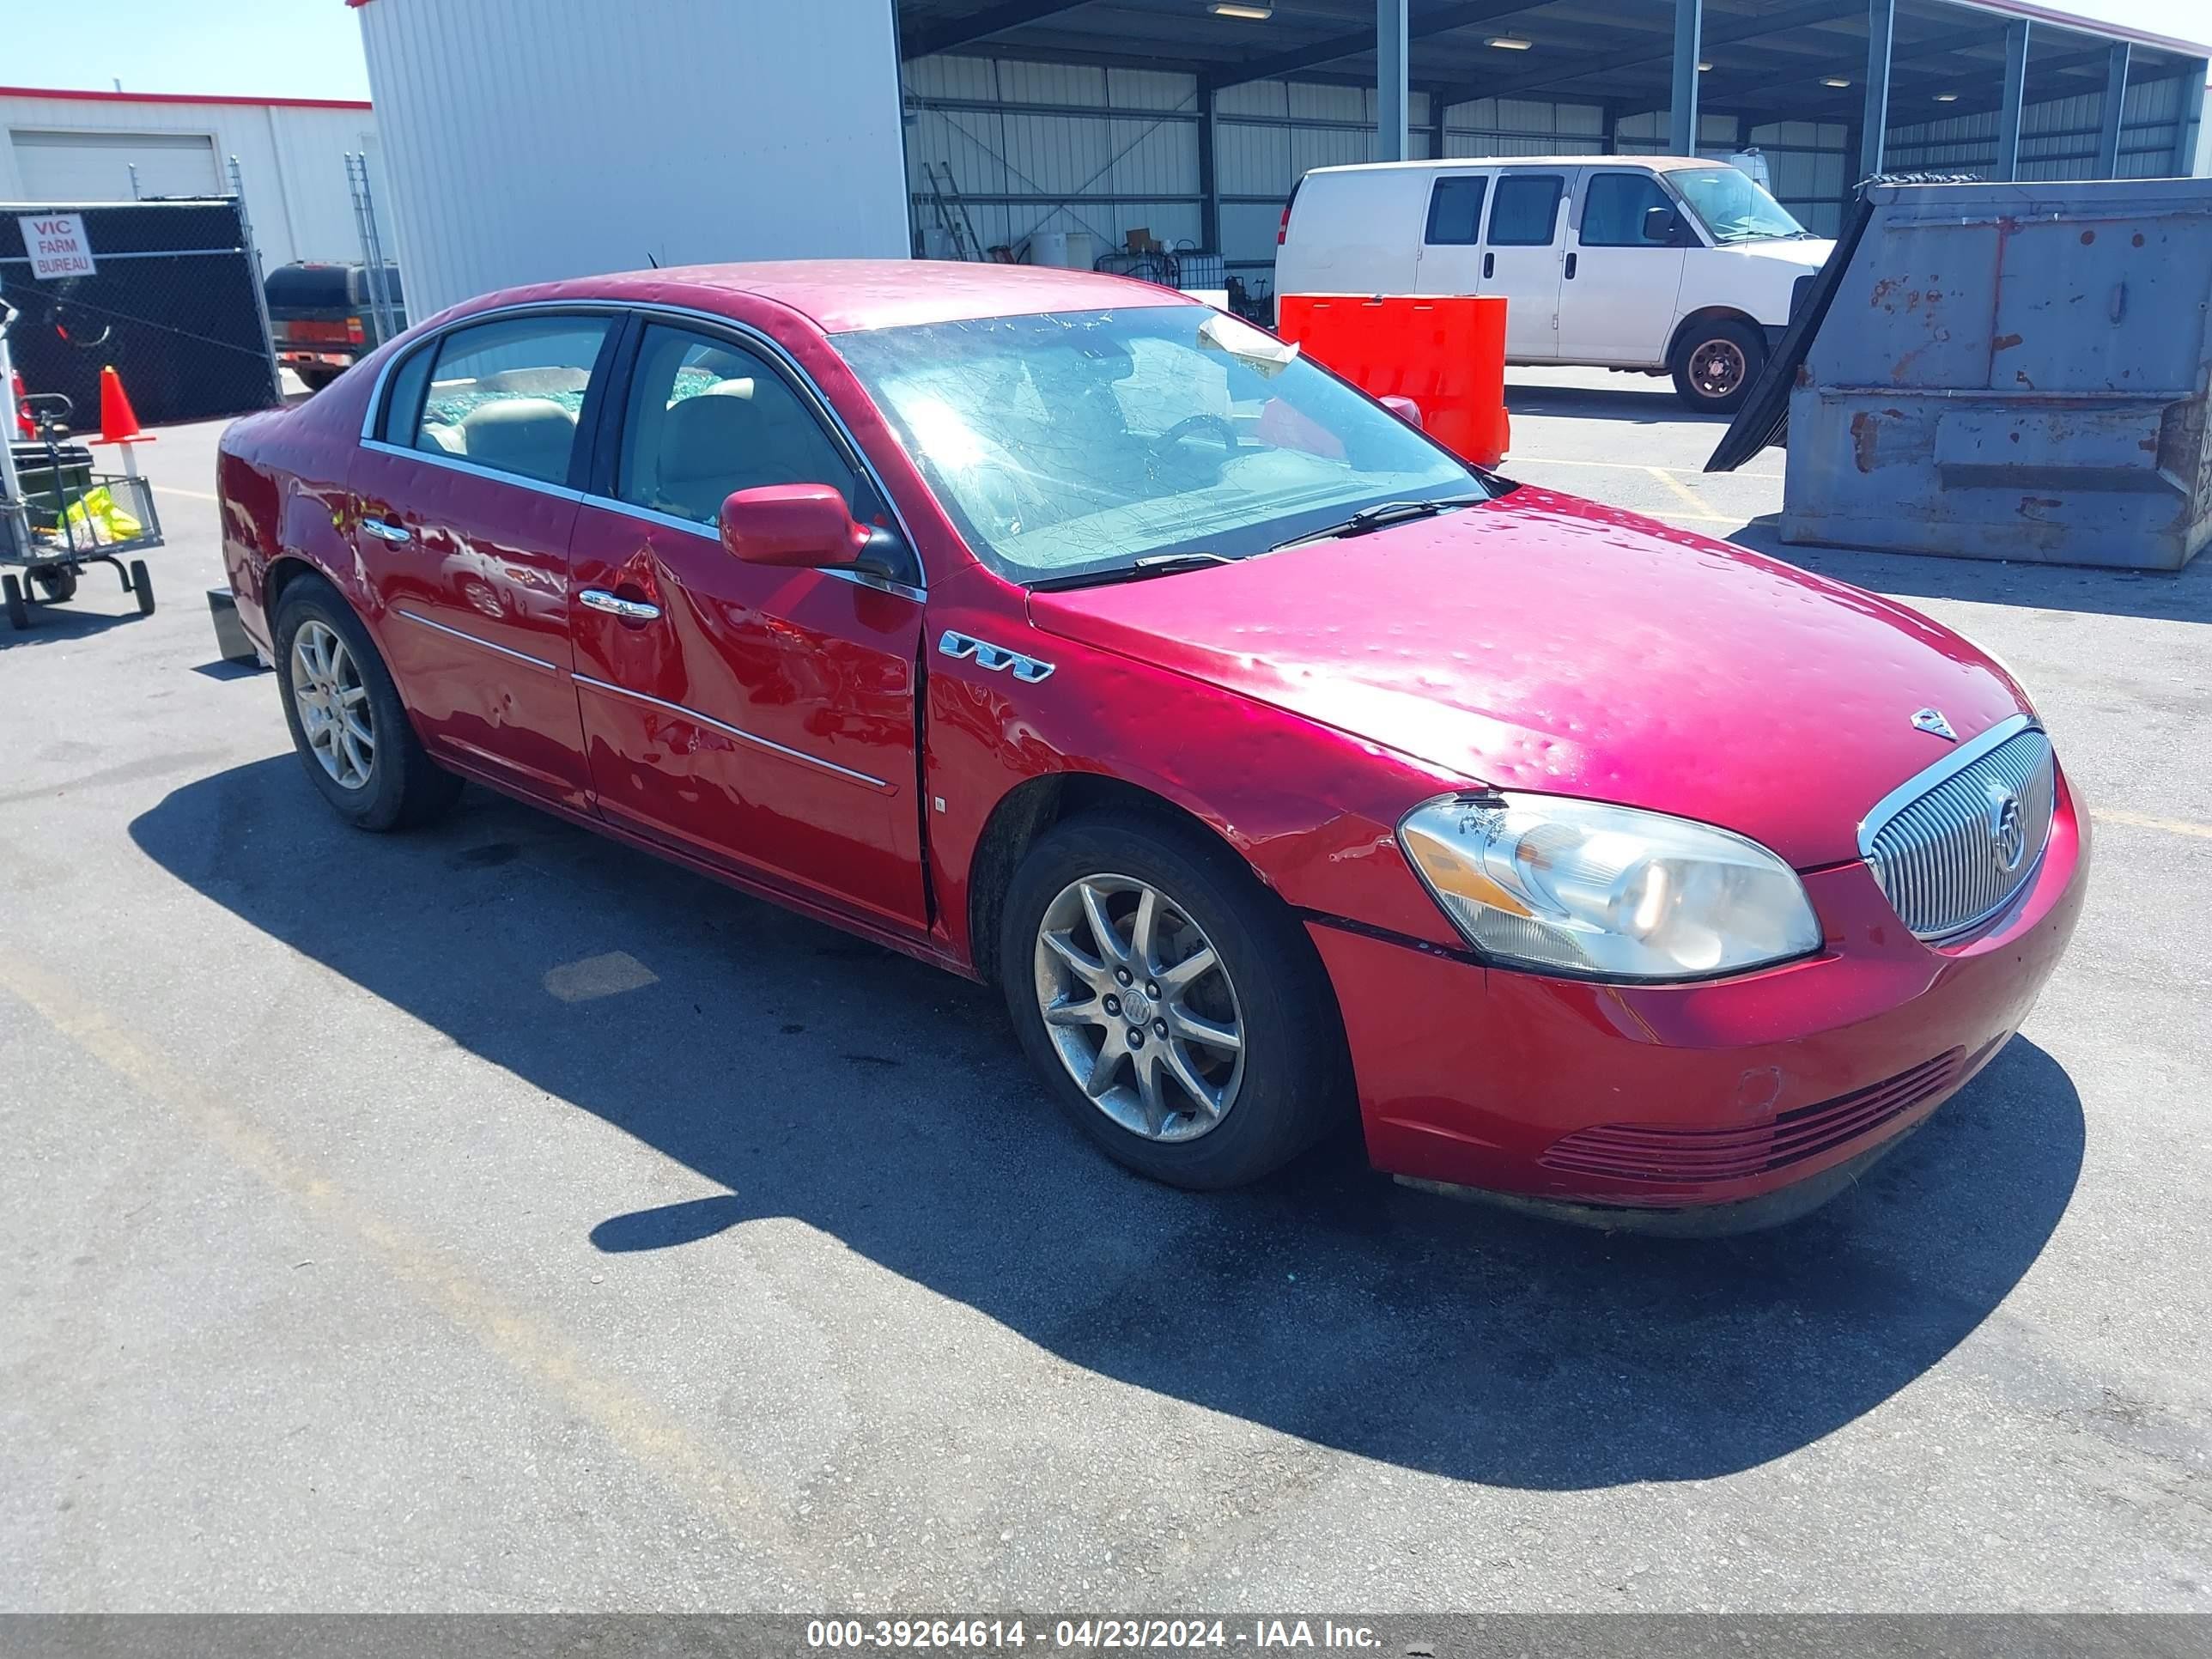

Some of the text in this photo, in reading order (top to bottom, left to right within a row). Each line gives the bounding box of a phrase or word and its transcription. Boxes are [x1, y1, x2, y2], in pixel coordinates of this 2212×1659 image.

[33, 220, 72, 235] VIC
[38, 238, 78, 254] FARM
[37, 256, 88, 273] BUREAU
